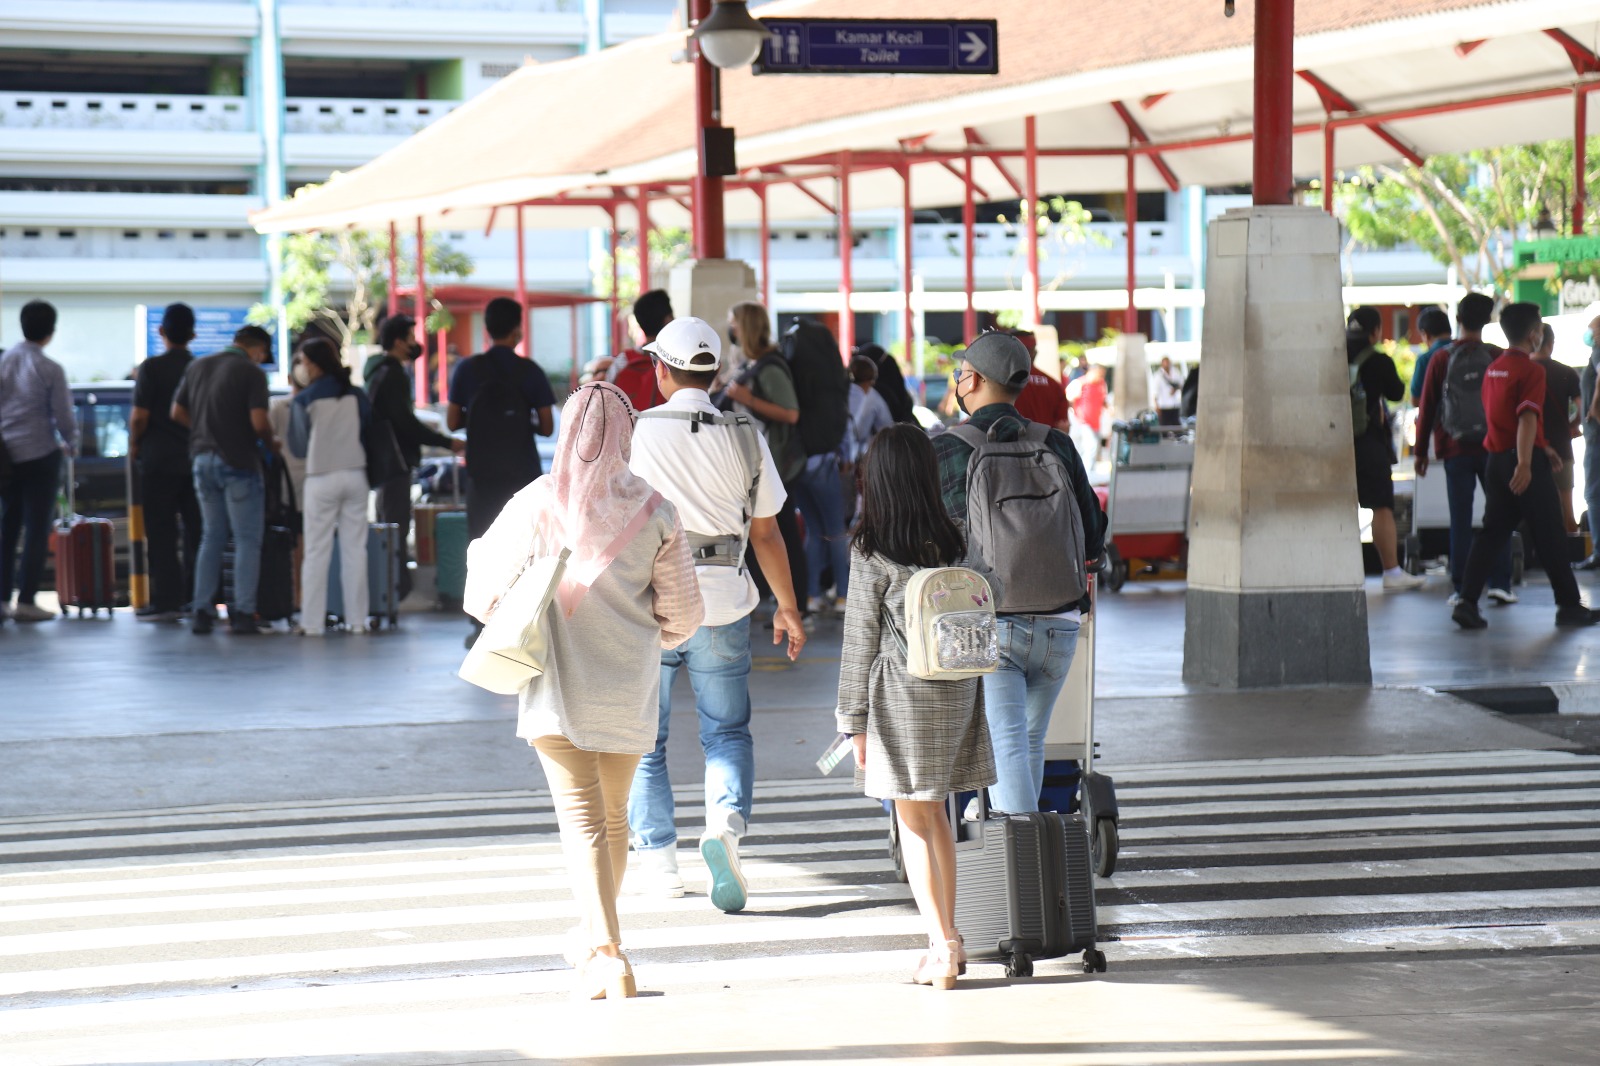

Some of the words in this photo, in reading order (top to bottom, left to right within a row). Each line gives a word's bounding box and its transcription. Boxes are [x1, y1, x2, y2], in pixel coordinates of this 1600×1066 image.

[835, 30, 884, 43] Kamar
[886, 30, 923, 44] Kecil
[861, 48, 899, 62] Toilet
[1563, 274, 1600, 306] Grab
